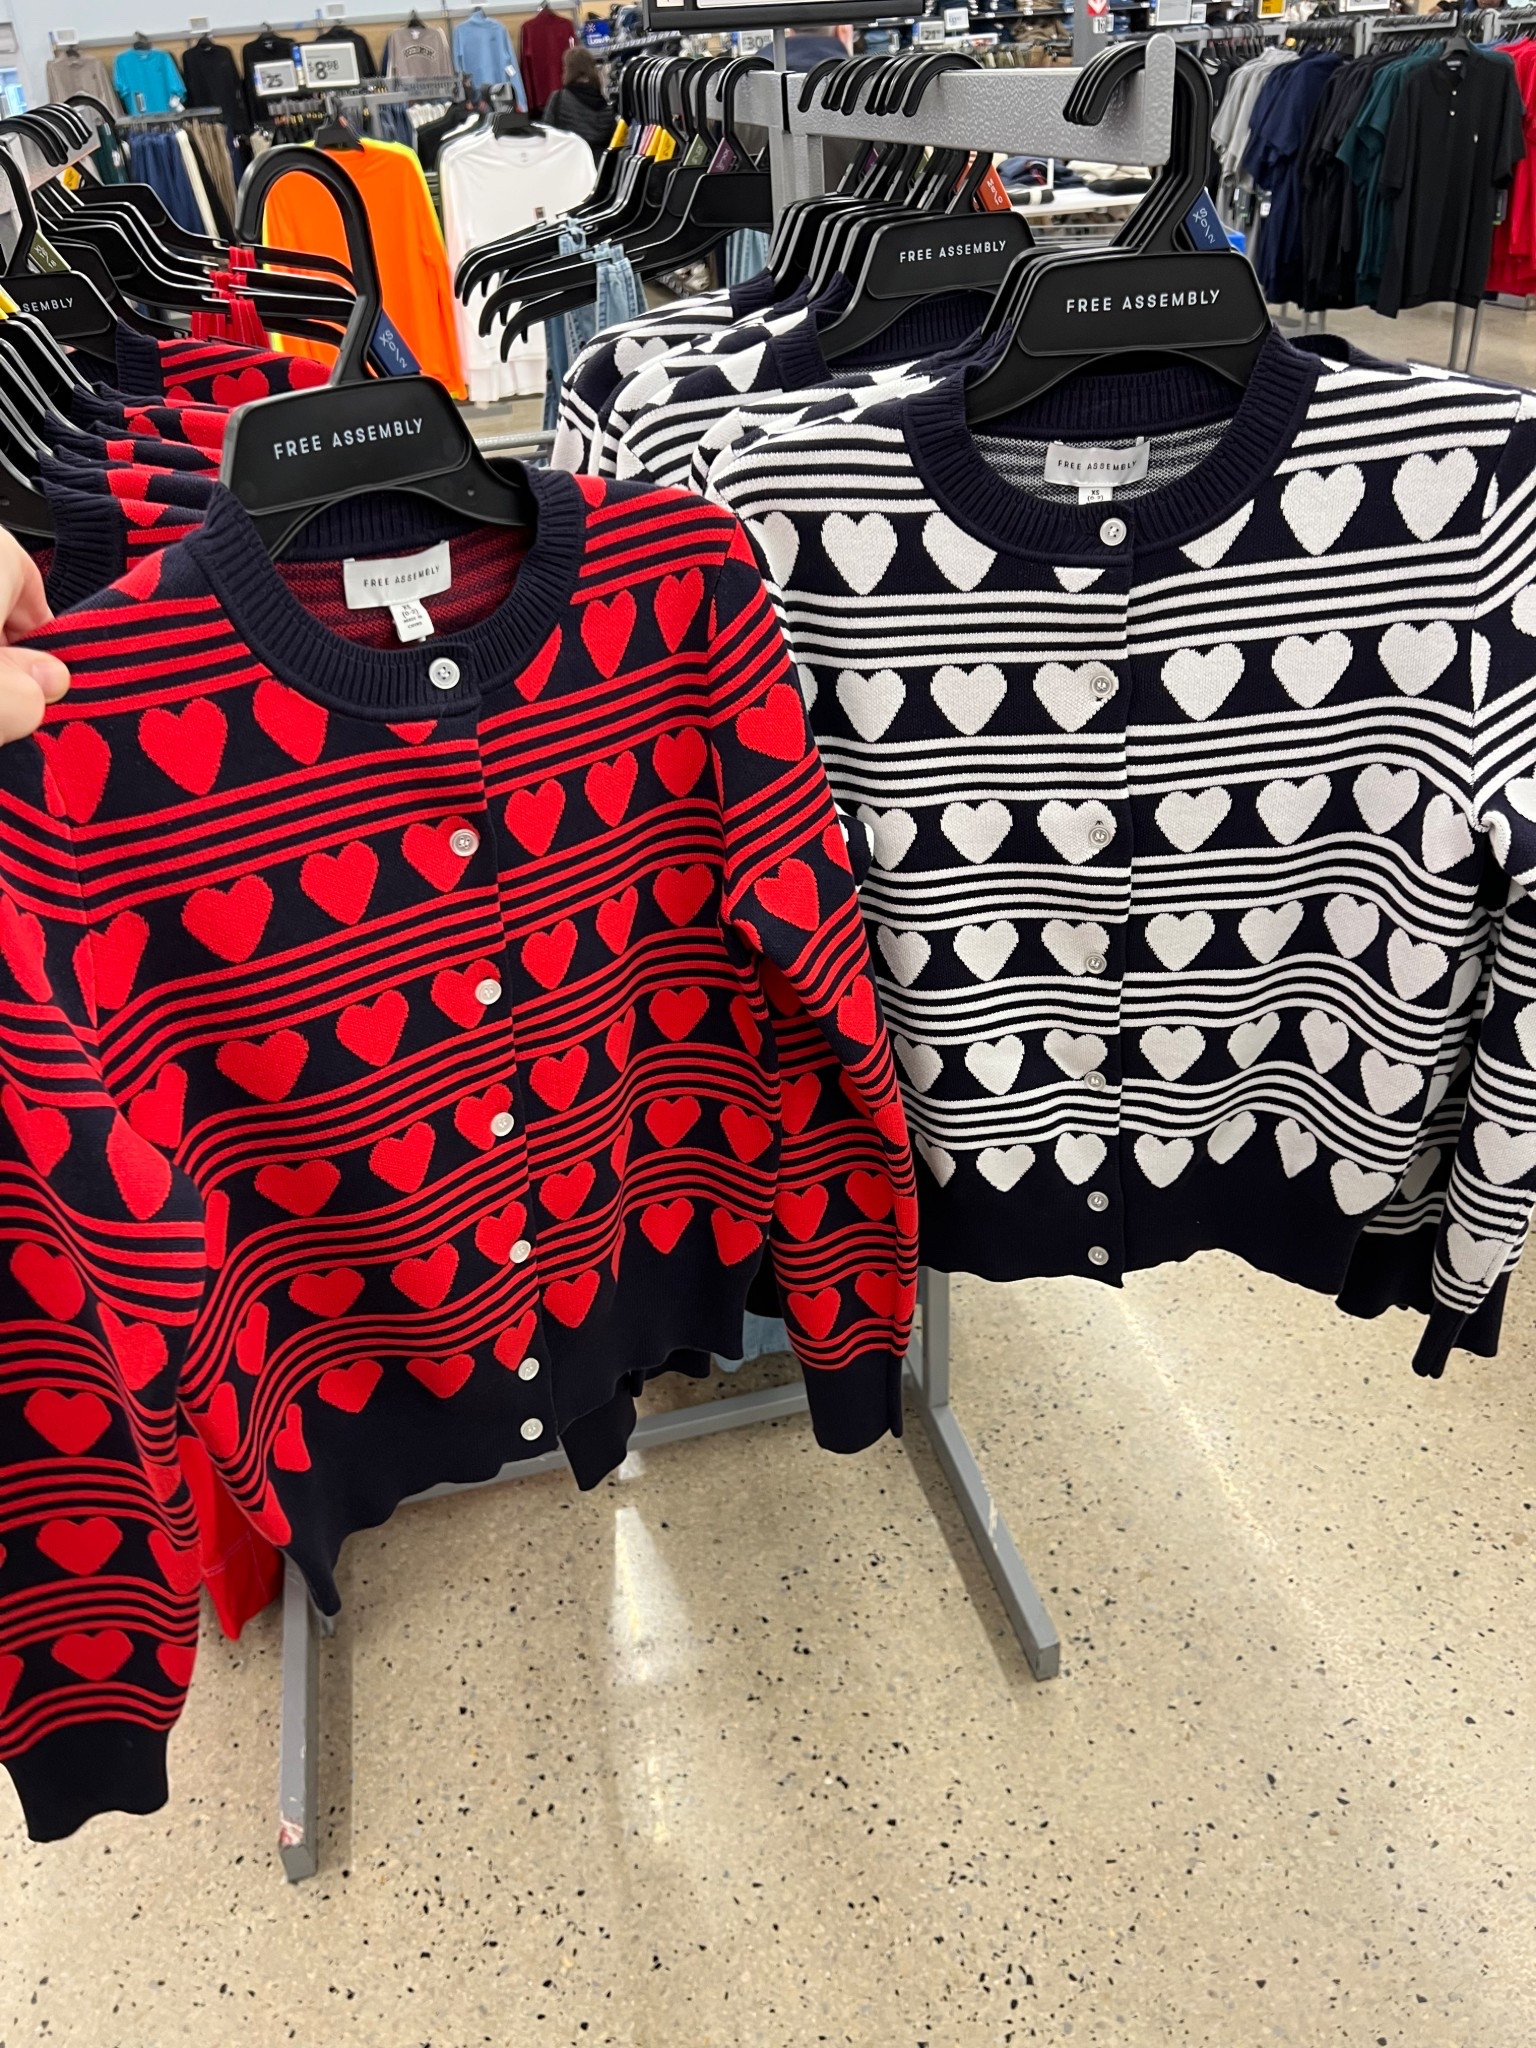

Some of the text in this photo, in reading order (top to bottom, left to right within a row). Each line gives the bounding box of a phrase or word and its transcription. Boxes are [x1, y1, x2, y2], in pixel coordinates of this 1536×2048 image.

[899, 240, 1006, 263] FREE ASSEMBLY
[22, 297, 73, 313] SEMBLY
[1066, 289, 1220, 313] FREE ASSEMBLY
[273, 417, 423, 460] FREE ASSEMBLY
[1057, 459, 1137, 471] FREE ASSEMBLY
[363, 564, 440, 587] FREE ASSEMBLY
